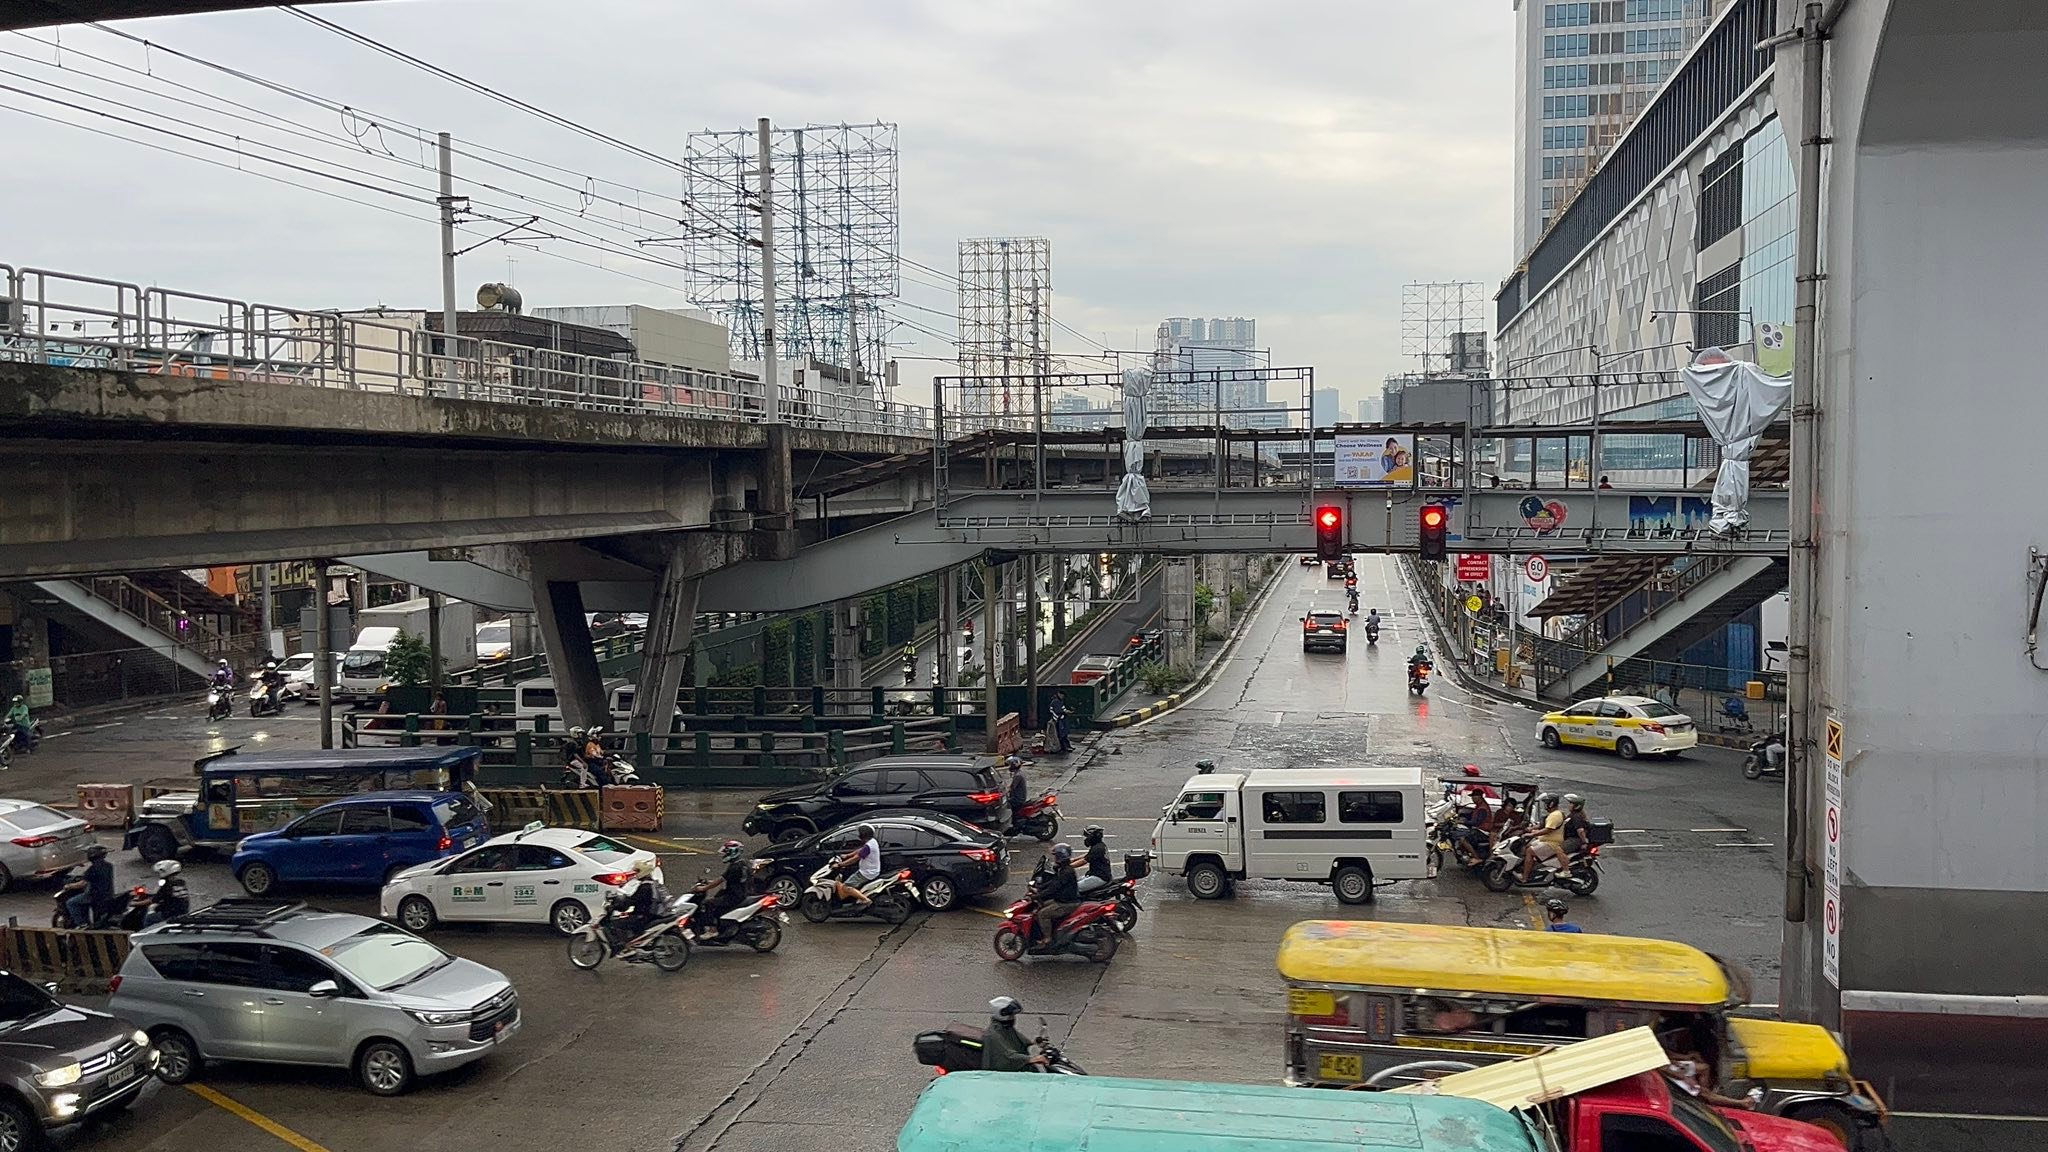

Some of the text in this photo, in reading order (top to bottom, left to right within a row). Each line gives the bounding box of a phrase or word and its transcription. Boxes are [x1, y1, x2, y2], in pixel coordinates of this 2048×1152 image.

[1530, 560, 1543, 572] 60
[1827, 758, 1833, 769] DO
[1827, 771, 1839, 785] BLOCK
[1829, 844, 1836, 857] NO
[1828, 857, 1838, 873] LEFT
[1826, 869, 1838, 887] TURN
[1826, 938, 1836, 959] NO
[1824, 956, 1838, 979] U-TURN
